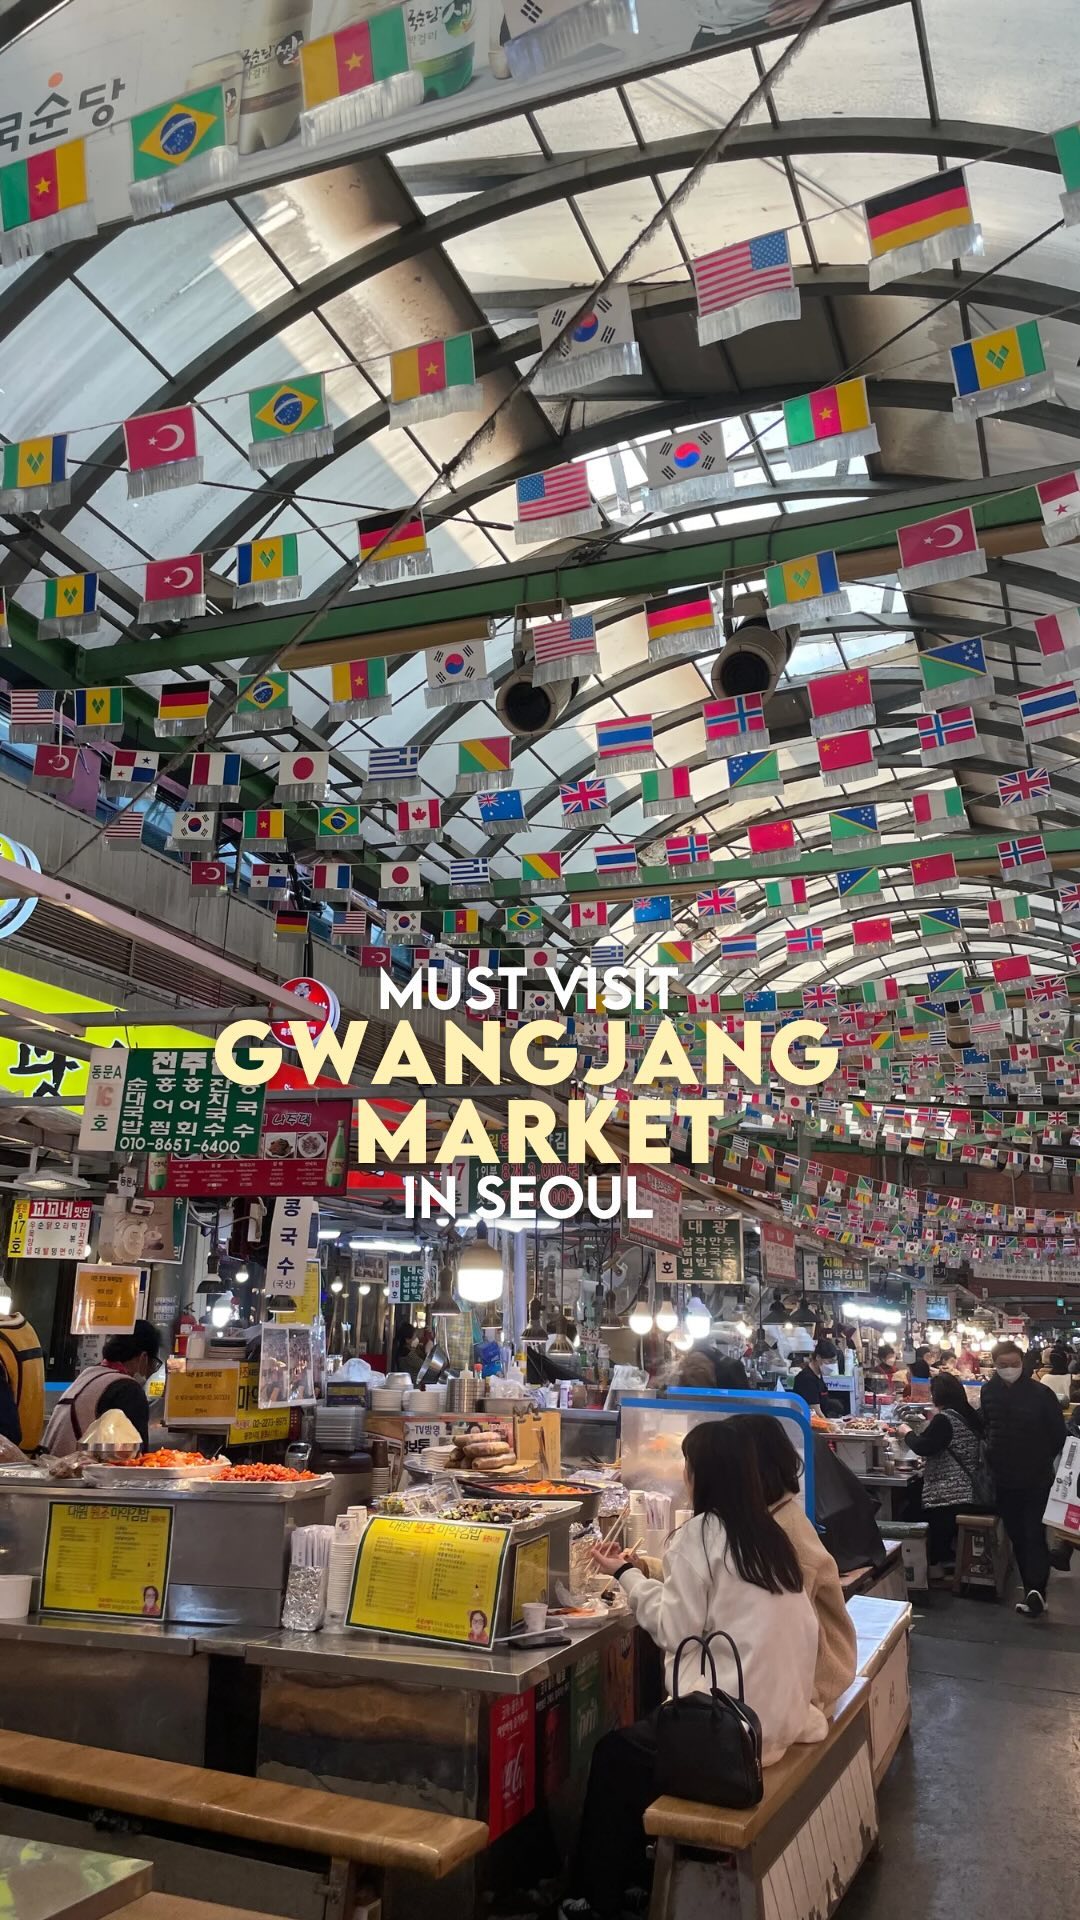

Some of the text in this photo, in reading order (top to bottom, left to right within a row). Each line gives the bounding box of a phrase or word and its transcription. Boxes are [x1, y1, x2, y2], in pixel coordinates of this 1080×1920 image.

[152, 1051, 237, 1076] 전주
[91, 1065, 122, 1080] 동문A
[90, 1114, 108, 1132] 호
[119, 1137, 241, 1154] 010-8651-6400
[73, 1207, 91, 1219] 맛집
[14, 1220, 26, 1234] 17
[688, 1220, 729, 1235] 대광
[10, 1237, 22, 1254] 호
[661, 1261, 674, 1274] 호
[273, 1279, 297, 1290] (국산)
